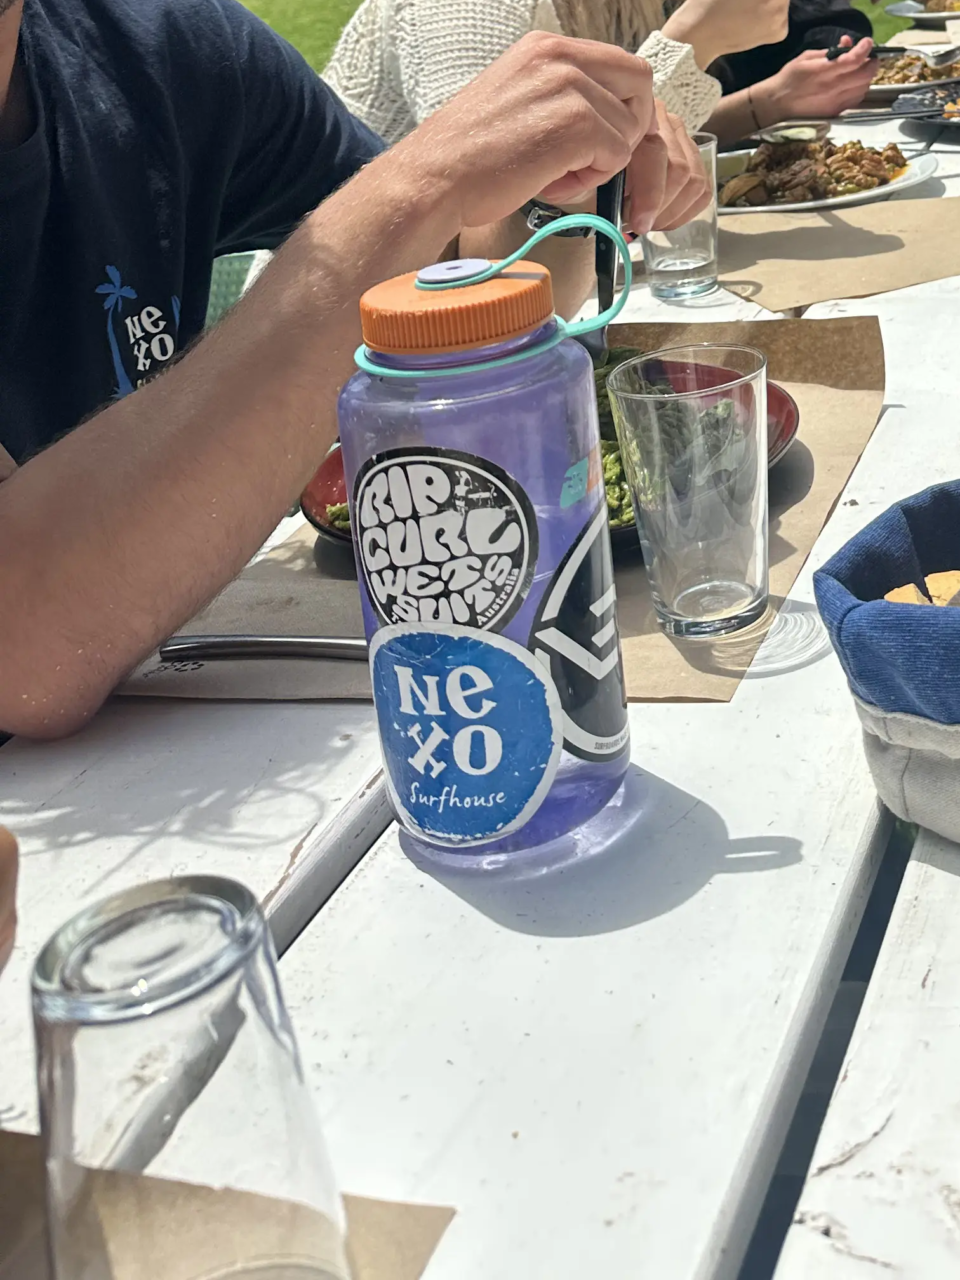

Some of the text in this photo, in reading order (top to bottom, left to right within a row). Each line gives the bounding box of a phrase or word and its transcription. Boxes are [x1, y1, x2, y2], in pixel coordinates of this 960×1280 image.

[361, 464, 451, 528] RIP
[362, 508, 521, 571] CURL
[476, 568, 519, 626] Australia
[410, 782, 507, 813] Surfhouse
